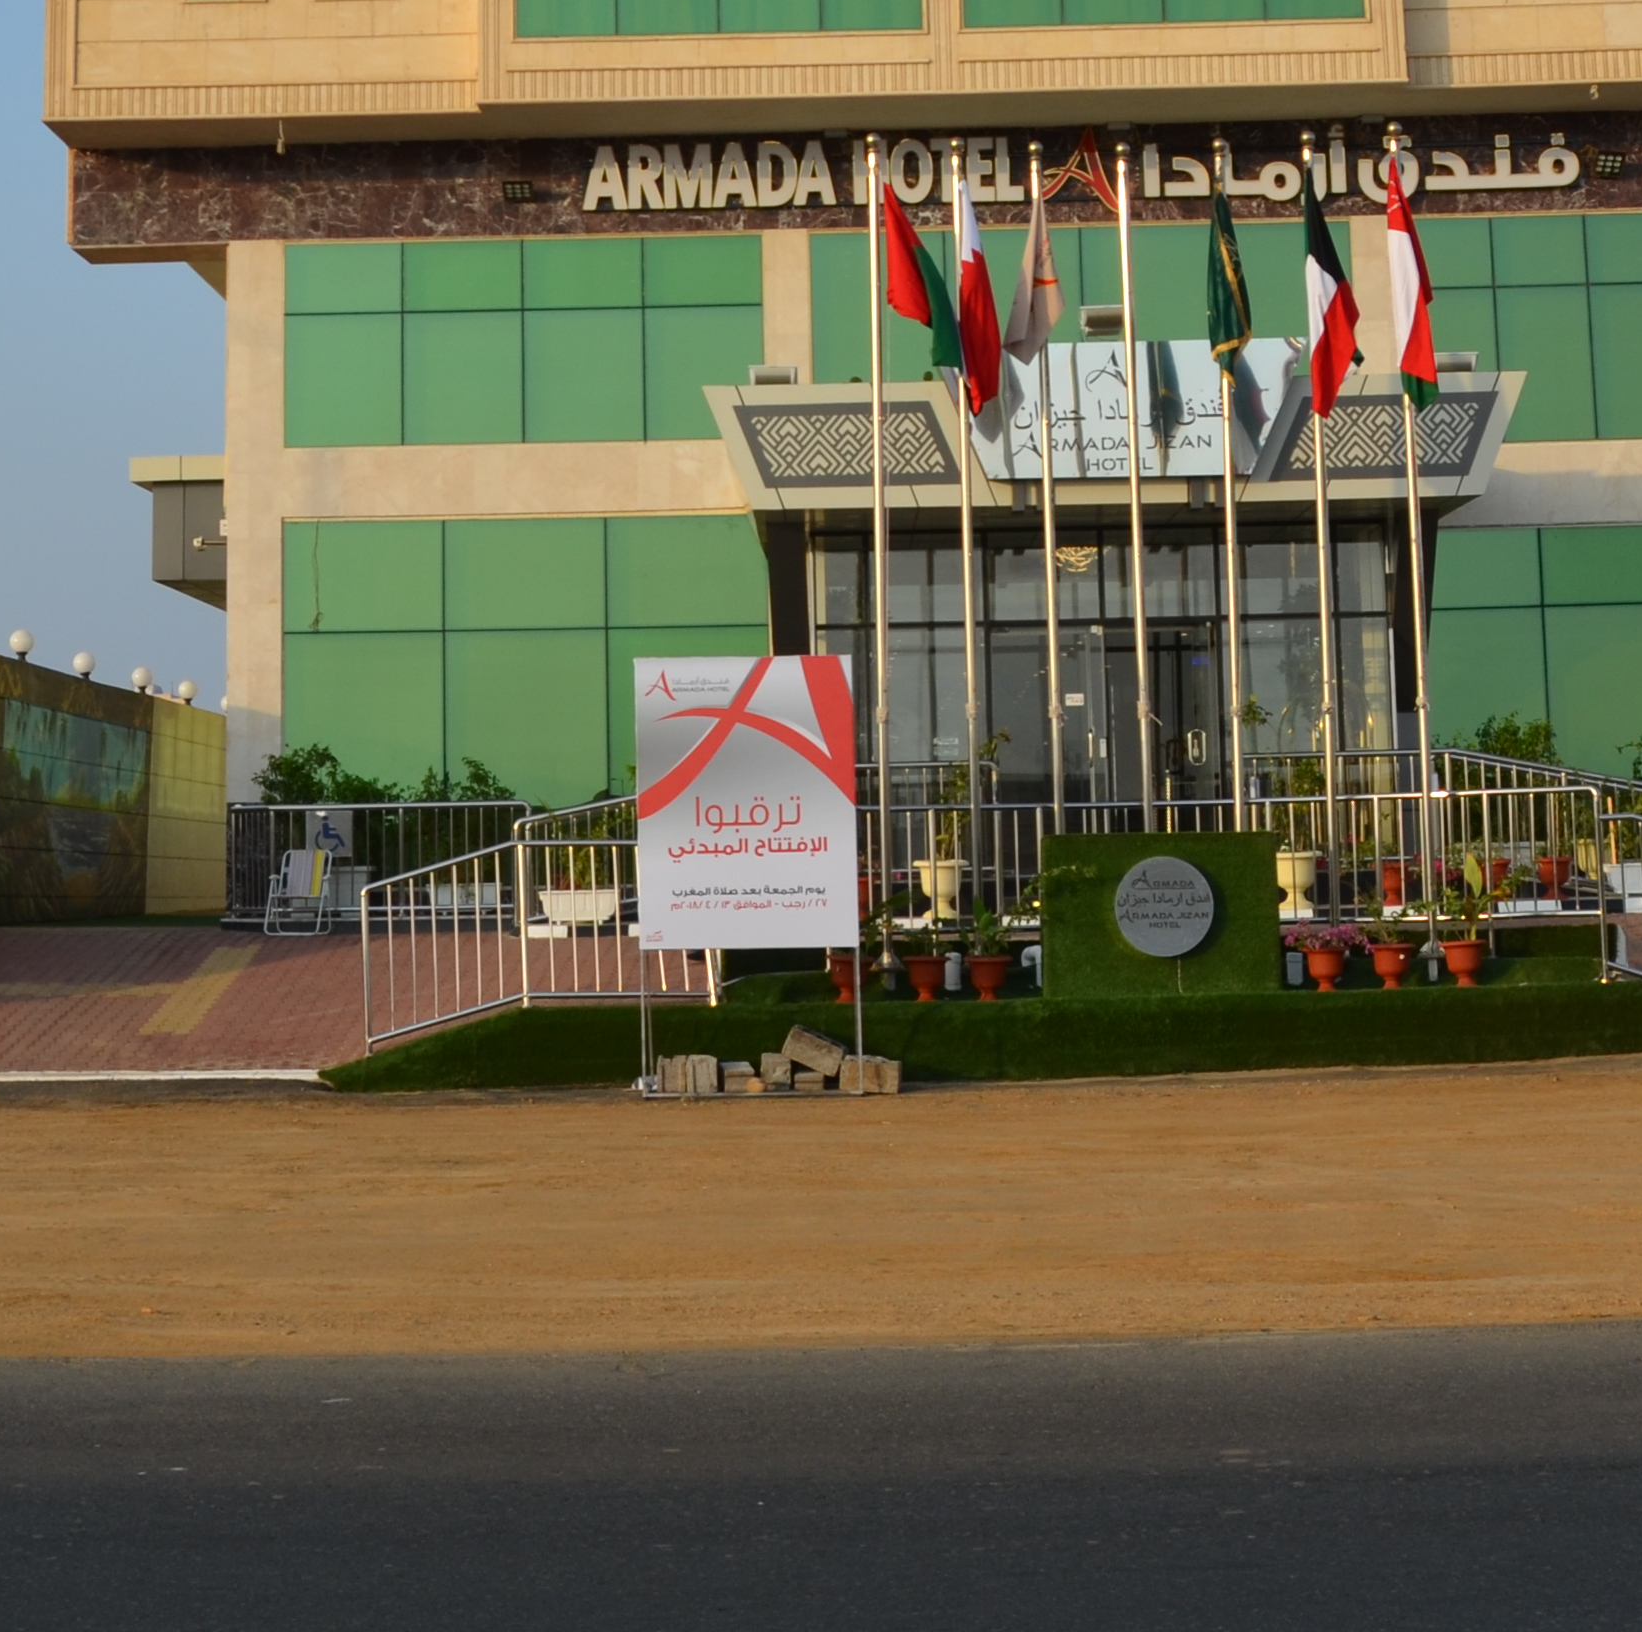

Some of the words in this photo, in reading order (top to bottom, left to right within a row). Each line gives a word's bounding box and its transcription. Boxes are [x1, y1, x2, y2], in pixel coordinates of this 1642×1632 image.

[582, 140, 838, 211] ARMADA
[853, 136, 1025, 205] HOTEL
[1086, 454, 1154, 471] HOTL
[695, 796, 801, 833] ترقبوا
[668, 837, 749, 864] المبدئي
[754, 836, 828, 857] الإفتتاح
[672, 886, 711, 898] المغرب
[713, 886, 739, 896] صلاة
[741, 887, 761, 897] بعد
[763, 884, 803, 896] الجمعة
[805, 887, 826, 896] يوم
[733, 899, 772, 911] الموافق
[781, 901, 806, 910] رجب
[1149, 921, 1182, 929] HOTEL
